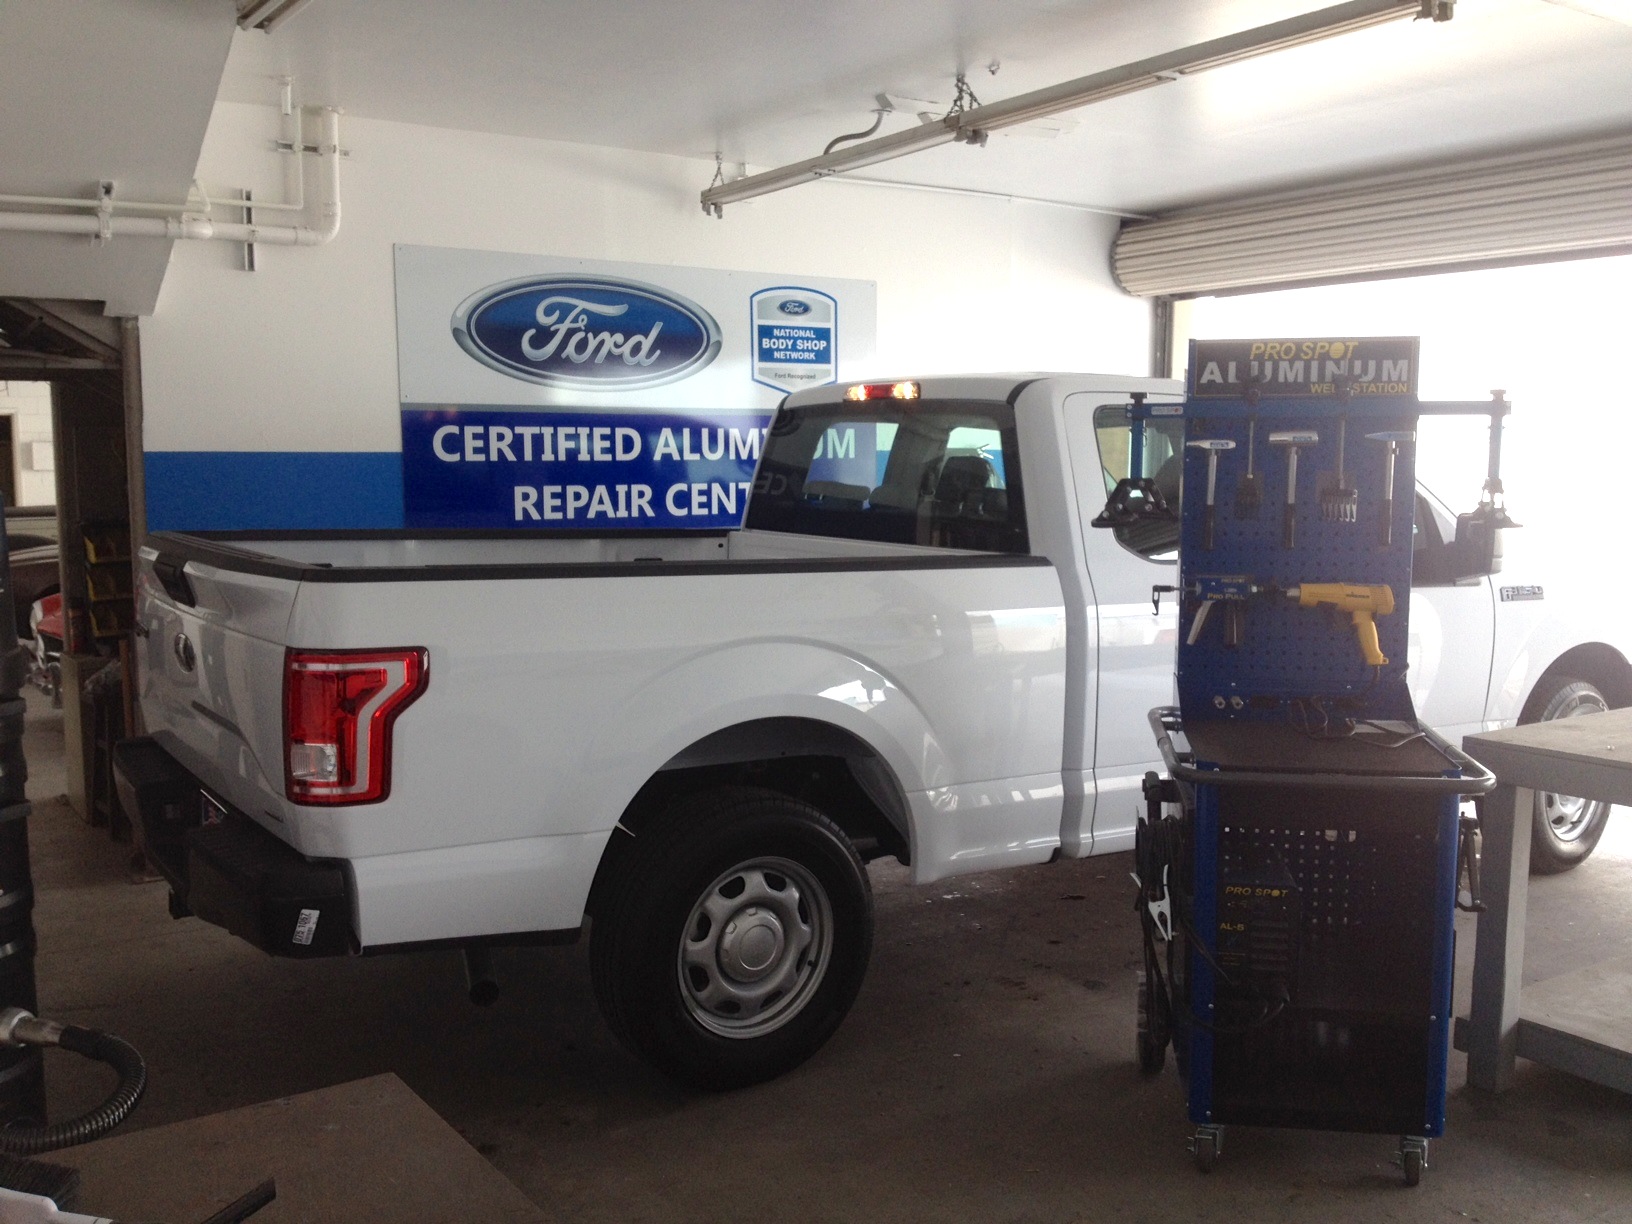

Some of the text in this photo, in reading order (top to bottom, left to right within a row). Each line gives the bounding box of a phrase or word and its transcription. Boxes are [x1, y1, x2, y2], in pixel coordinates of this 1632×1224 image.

[784, 302, 805, 313] Ford
[521, 296, 664, 366] Ford
[773, 328, 816, 338] NATIONAL
[762, 338, 827, 351] BODY SHOP
[1250, 341, 1359, 360] PRO SPOT
[774, 351, 816, 360] NETWORK
[1310, 382, 1408, 394] WEL STATION
[432, 425, 855, 462] CERTIFIED ALUMM
[514, 482, 752, 521] REPAIR CEN
[1225, 886, 1288, 897] PRO SPOT
